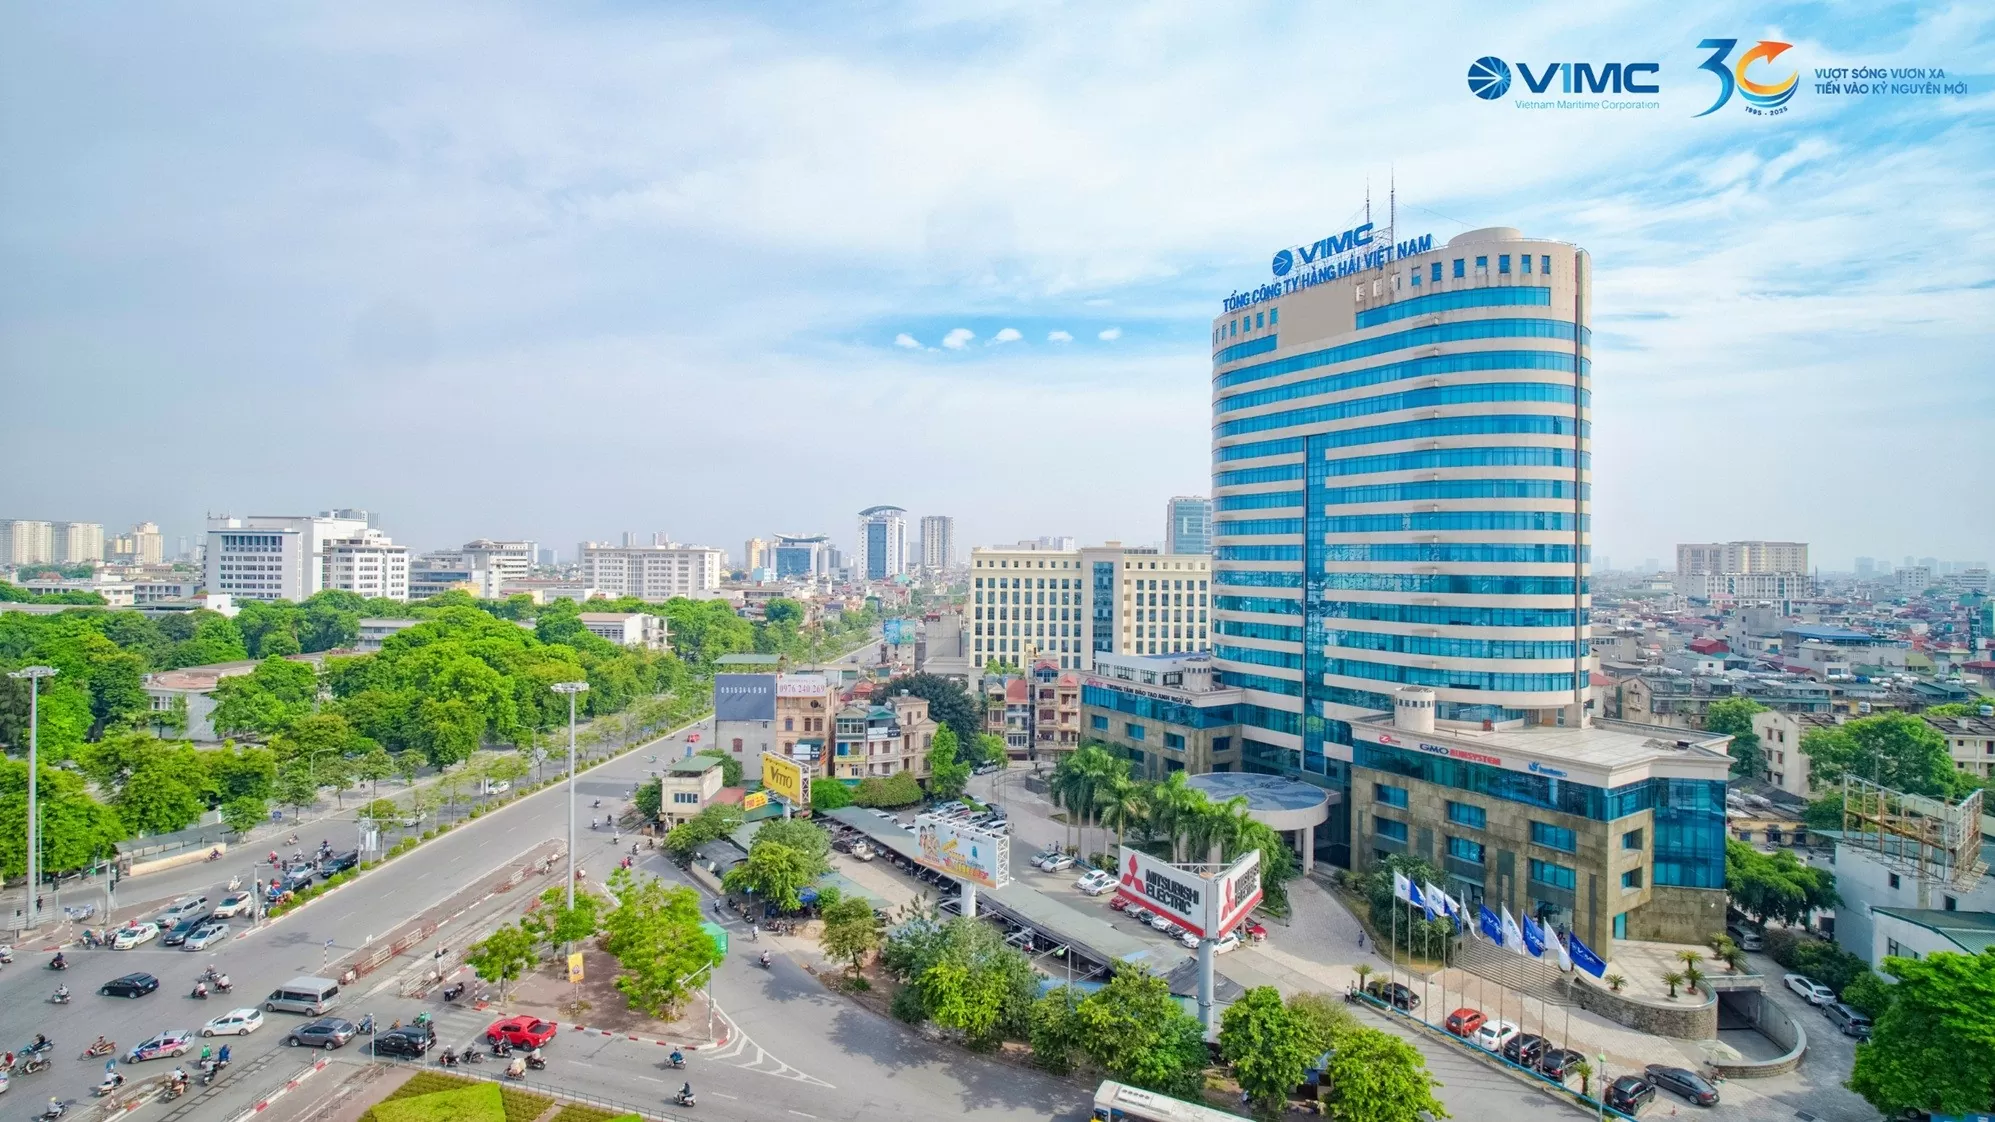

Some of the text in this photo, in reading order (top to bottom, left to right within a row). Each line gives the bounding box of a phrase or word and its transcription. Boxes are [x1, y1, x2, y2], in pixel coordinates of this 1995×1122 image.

[1223, 233, 1432, 312] TỔNG CÔNG TY HÀNG HẢI VIỆT NAM
[1420, 743, 1449, 755] GMO
[1145, 868, 1200, 905] MITSUBISHI
[1145, 882, 1192, 916] ELECTRIC
